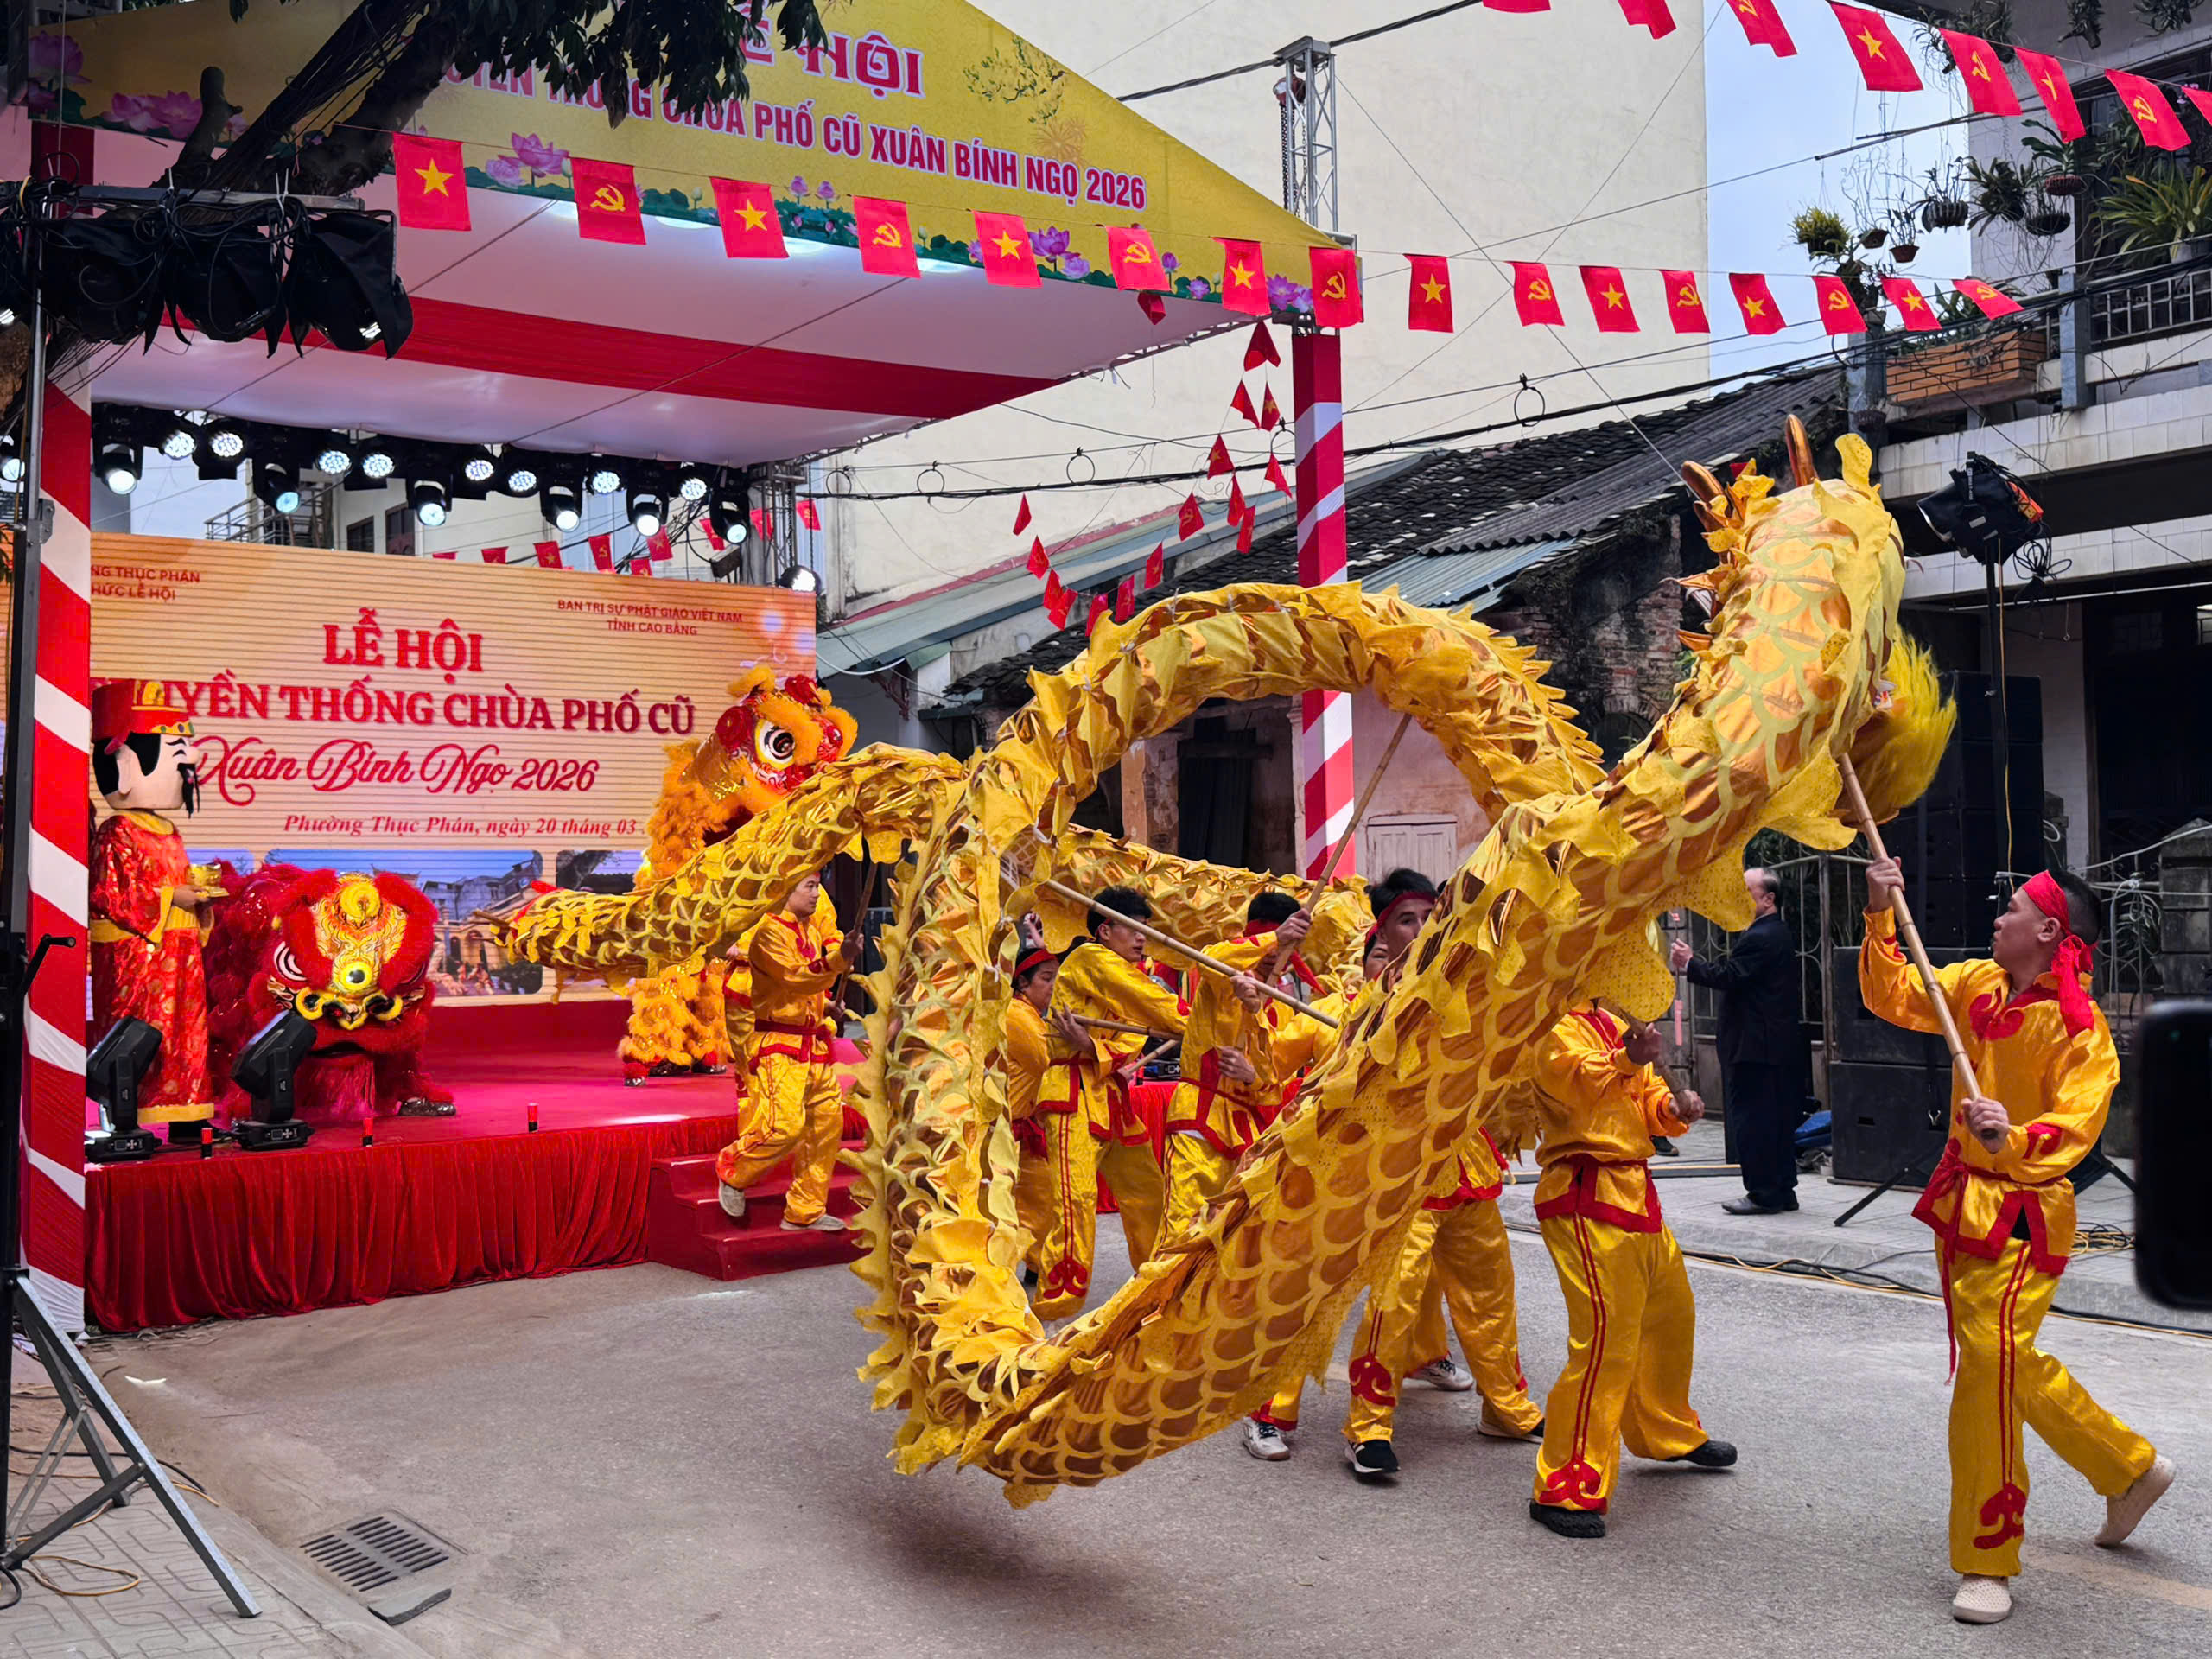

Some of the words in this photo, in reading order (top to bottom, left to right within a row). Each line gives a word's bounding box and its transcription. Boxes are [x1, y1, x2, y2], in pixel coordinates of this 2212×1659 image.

[796, 30, 925, 100] HỘI
[753, 99, 815, 149] PHỐ
[823, 114, 861, 158] CŨ
[869, 124, 948, 175] XUÂN
[954, 137, 1019, 188] BÍNH
[1025, 155, 1079, 206] NGỌ
[1085, 167, 1147, 211] 2026
[91, 564, 111, 577] NG
[91, 582, 125, 597] HỨC
[149, 586, 176, 602] HỘI
[557, 600, 582, 611] BAN
[586, 601, 605, 615] TRỊ
[661, 607, 689, 620] GIÁO
[691, 608, 714, 622] VIỆT
[718, 612, 743, 623] NAM
[639, 622, 663, 633] CAO
[323, 607, 385, 667] LỄ
[395, 618, 484, 685] HỘI
[90, 668, 271, 720] YỀN
[278, 674, 435, 725] THỐNG
[443, 683, 555, 730] CHÙA
[562, 688, 641, 734] PHỐ
[648, 695, 696, 734] CŨ
[192, 735, 302, 806] Xuân
[307, 739, 415, 791] Bính
[419, 743, 513, 794] Ngọ
[511, 758, 600, 791] 2026
[283, 815, 364, 837] Phường
[372, 816, 420, 837] Thục
[425, 816, 480, 835] Phán,
[486, 817, 530, 838] ngày
[536, 818, 556, 834] 20
[562, 817, 612, 839] tháng
[617, 819, 637, 835] 03
